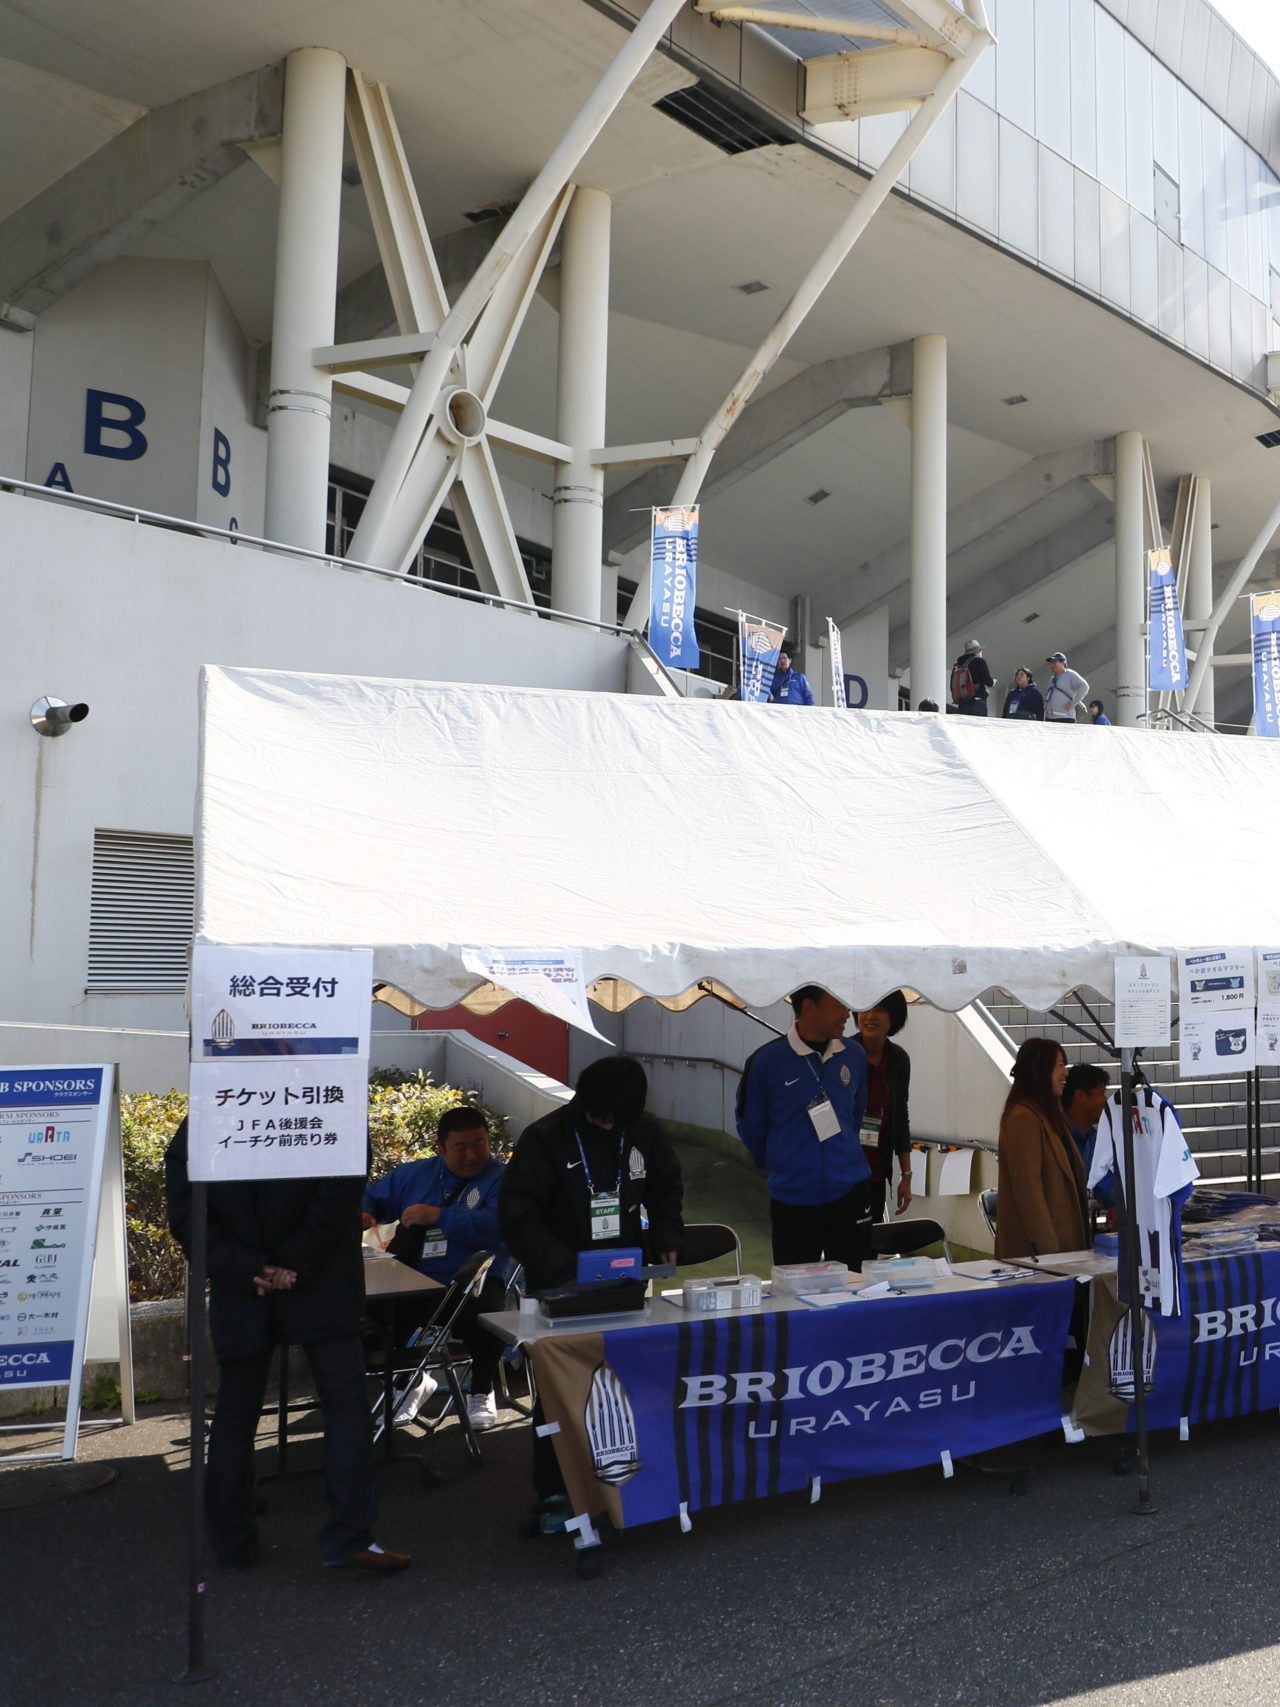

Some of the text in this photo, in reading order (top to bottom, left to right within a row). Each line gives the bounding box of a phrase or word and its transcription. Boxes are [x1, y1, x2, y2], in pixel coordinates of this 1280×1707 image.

[84, 388, 148, 461] B
[212, 426, 231, 498] B
[661, 538, 674, 628] URAYASU
[669, 537, 688, 659] BRIOBECCA
[1164, 585, 1181, 684] BRIOBECCA
[843, 673, 868, 708] D
[1262, 651, 1274, 723] URAYASU
[229, 975, 339, 998] 総合受付
[251, 1022, 317, 1030] BRIOBECCA
[13, 1079, 95, 1093] SPONSORS
[215, 1085, 345, 1107] チケット引換
[15, 1110, 60, 1119] SPONSORS
[218, 1132, 338, 1149] イーチケ前売り券
[595, 1207, 615, 1215] STAFF
[678, 1325, 1042, 1409] BRIOBECCA
[747, 1380, 977, 1440] URAYASU
